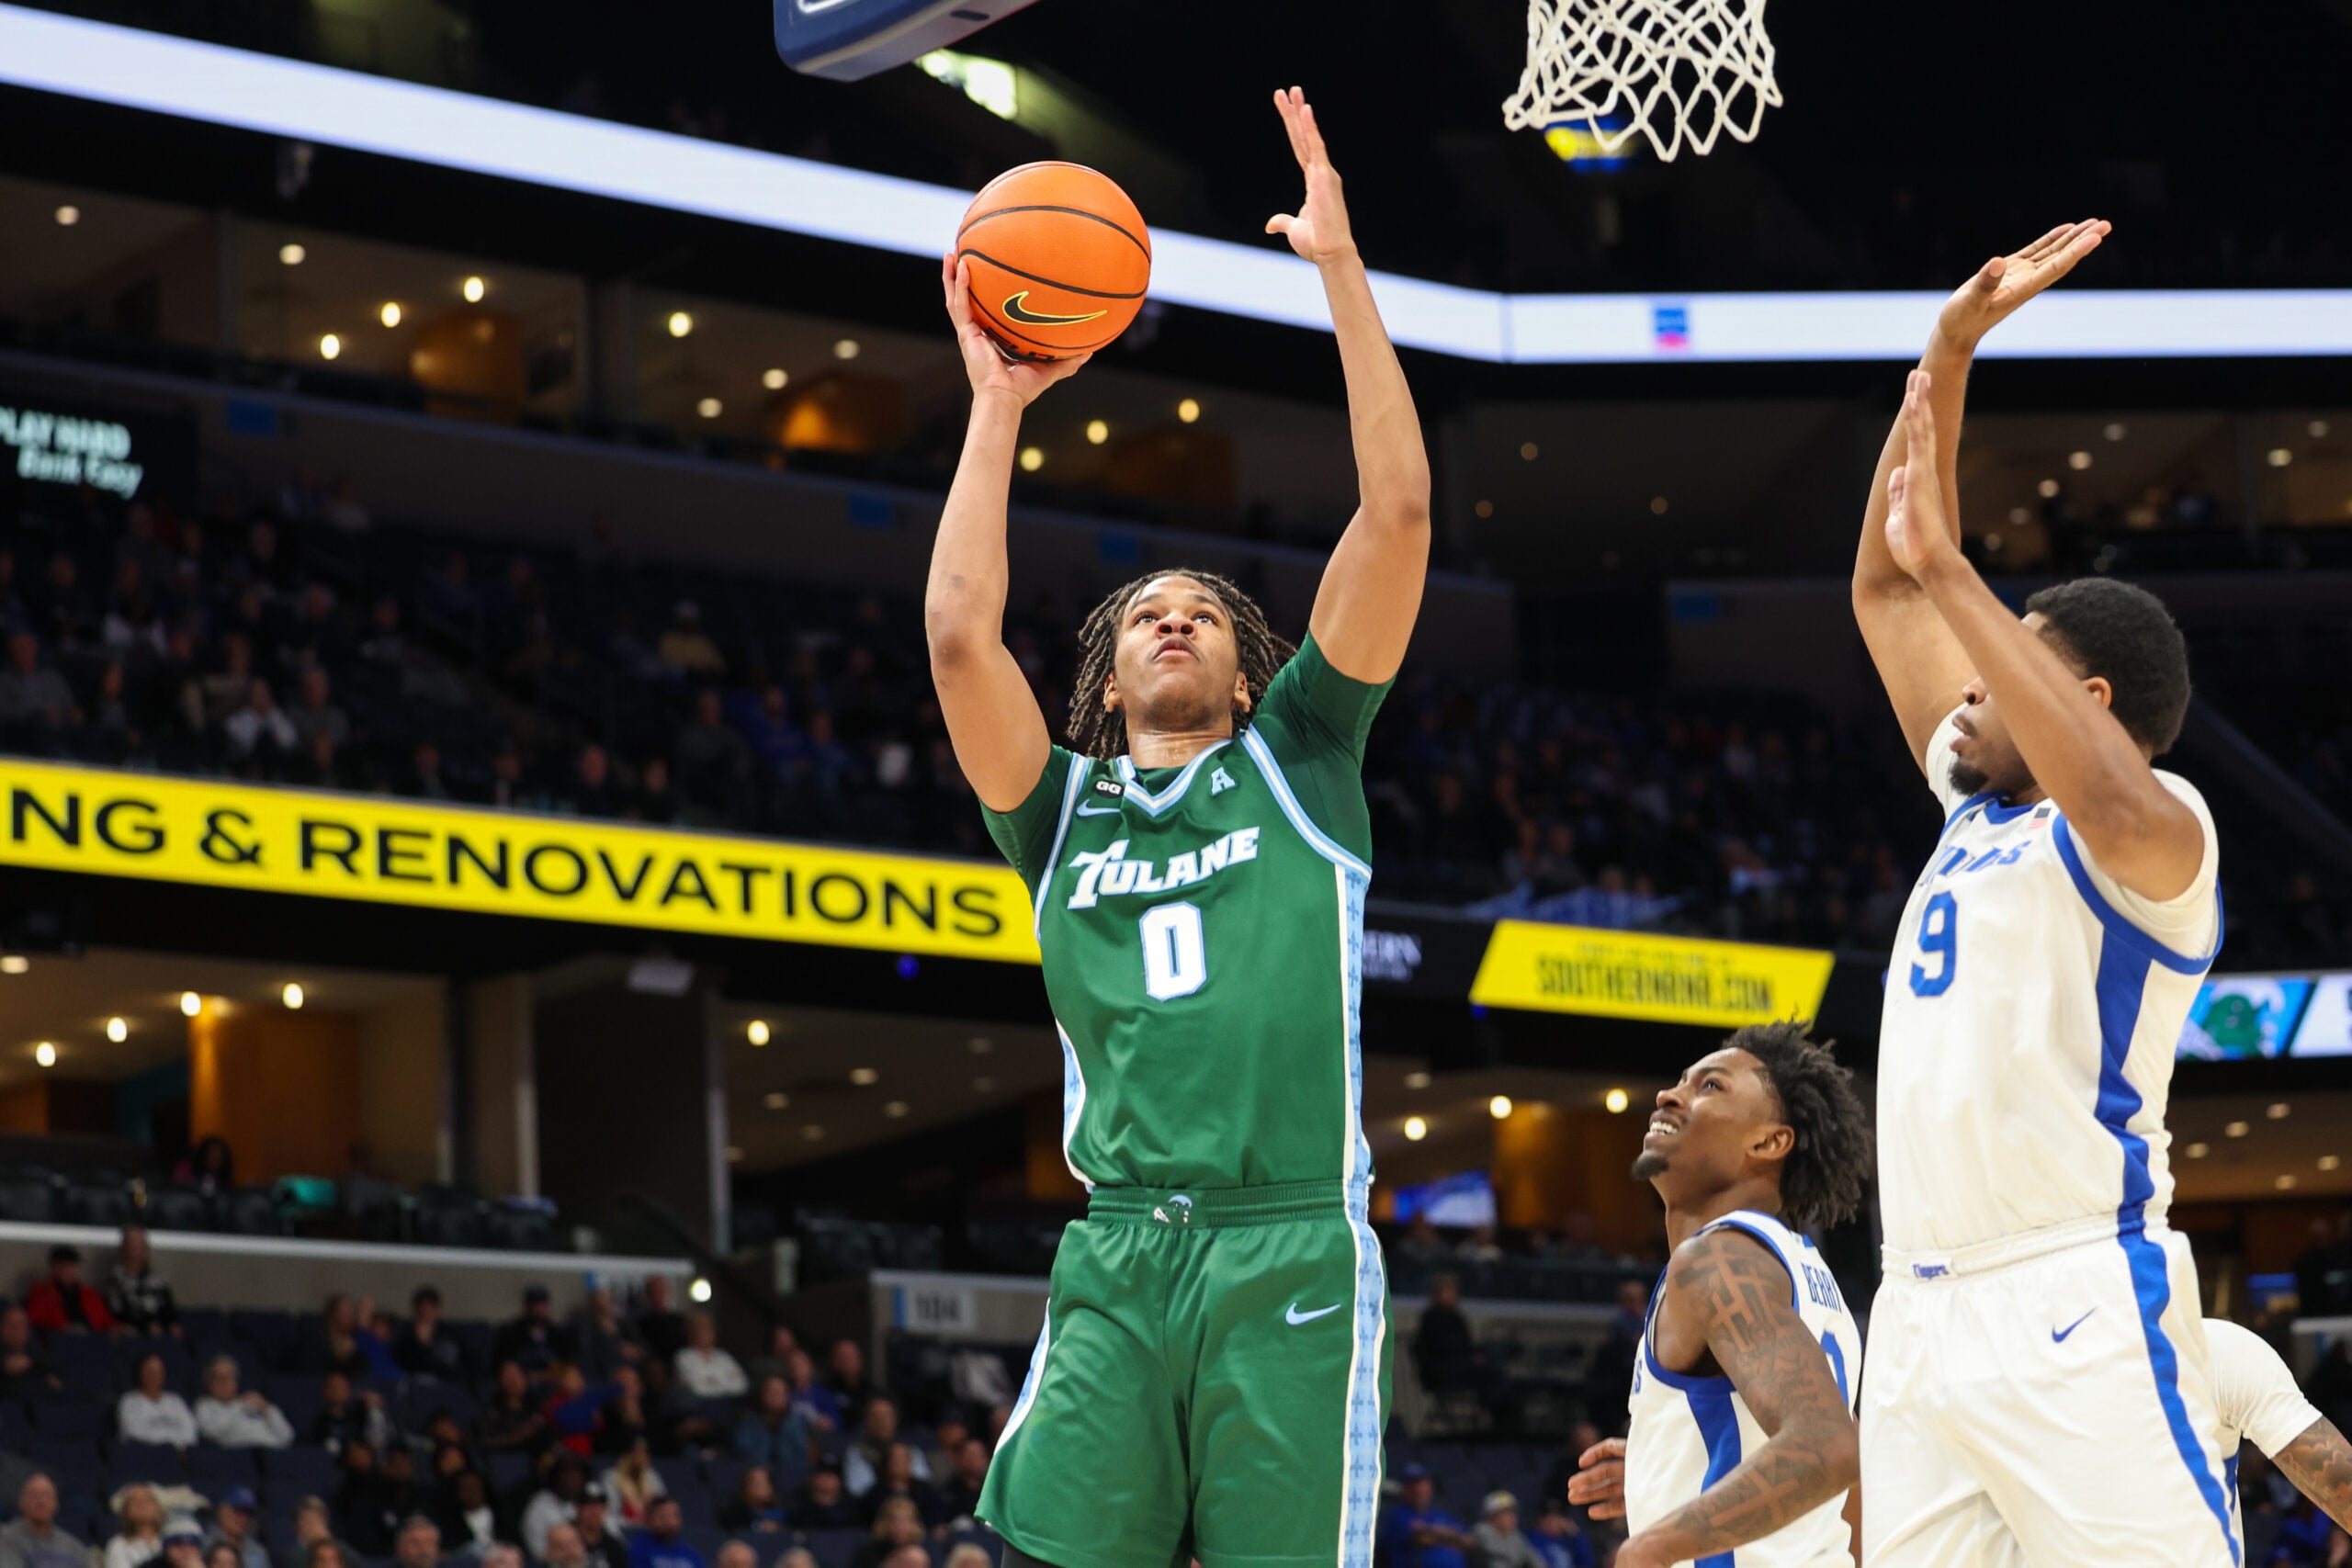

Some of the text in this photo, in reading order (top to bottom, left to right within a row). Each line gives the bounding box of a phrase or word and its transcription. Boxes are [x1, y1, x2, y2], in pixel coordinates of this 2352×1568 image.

[11, 787, 1002, 939] NG & RENOVATIONS
[1067, 826, 1261, 909] TULANE
[1138, 900, 1207, 1003] 0
[1908, 889, 1958, 998] 9
